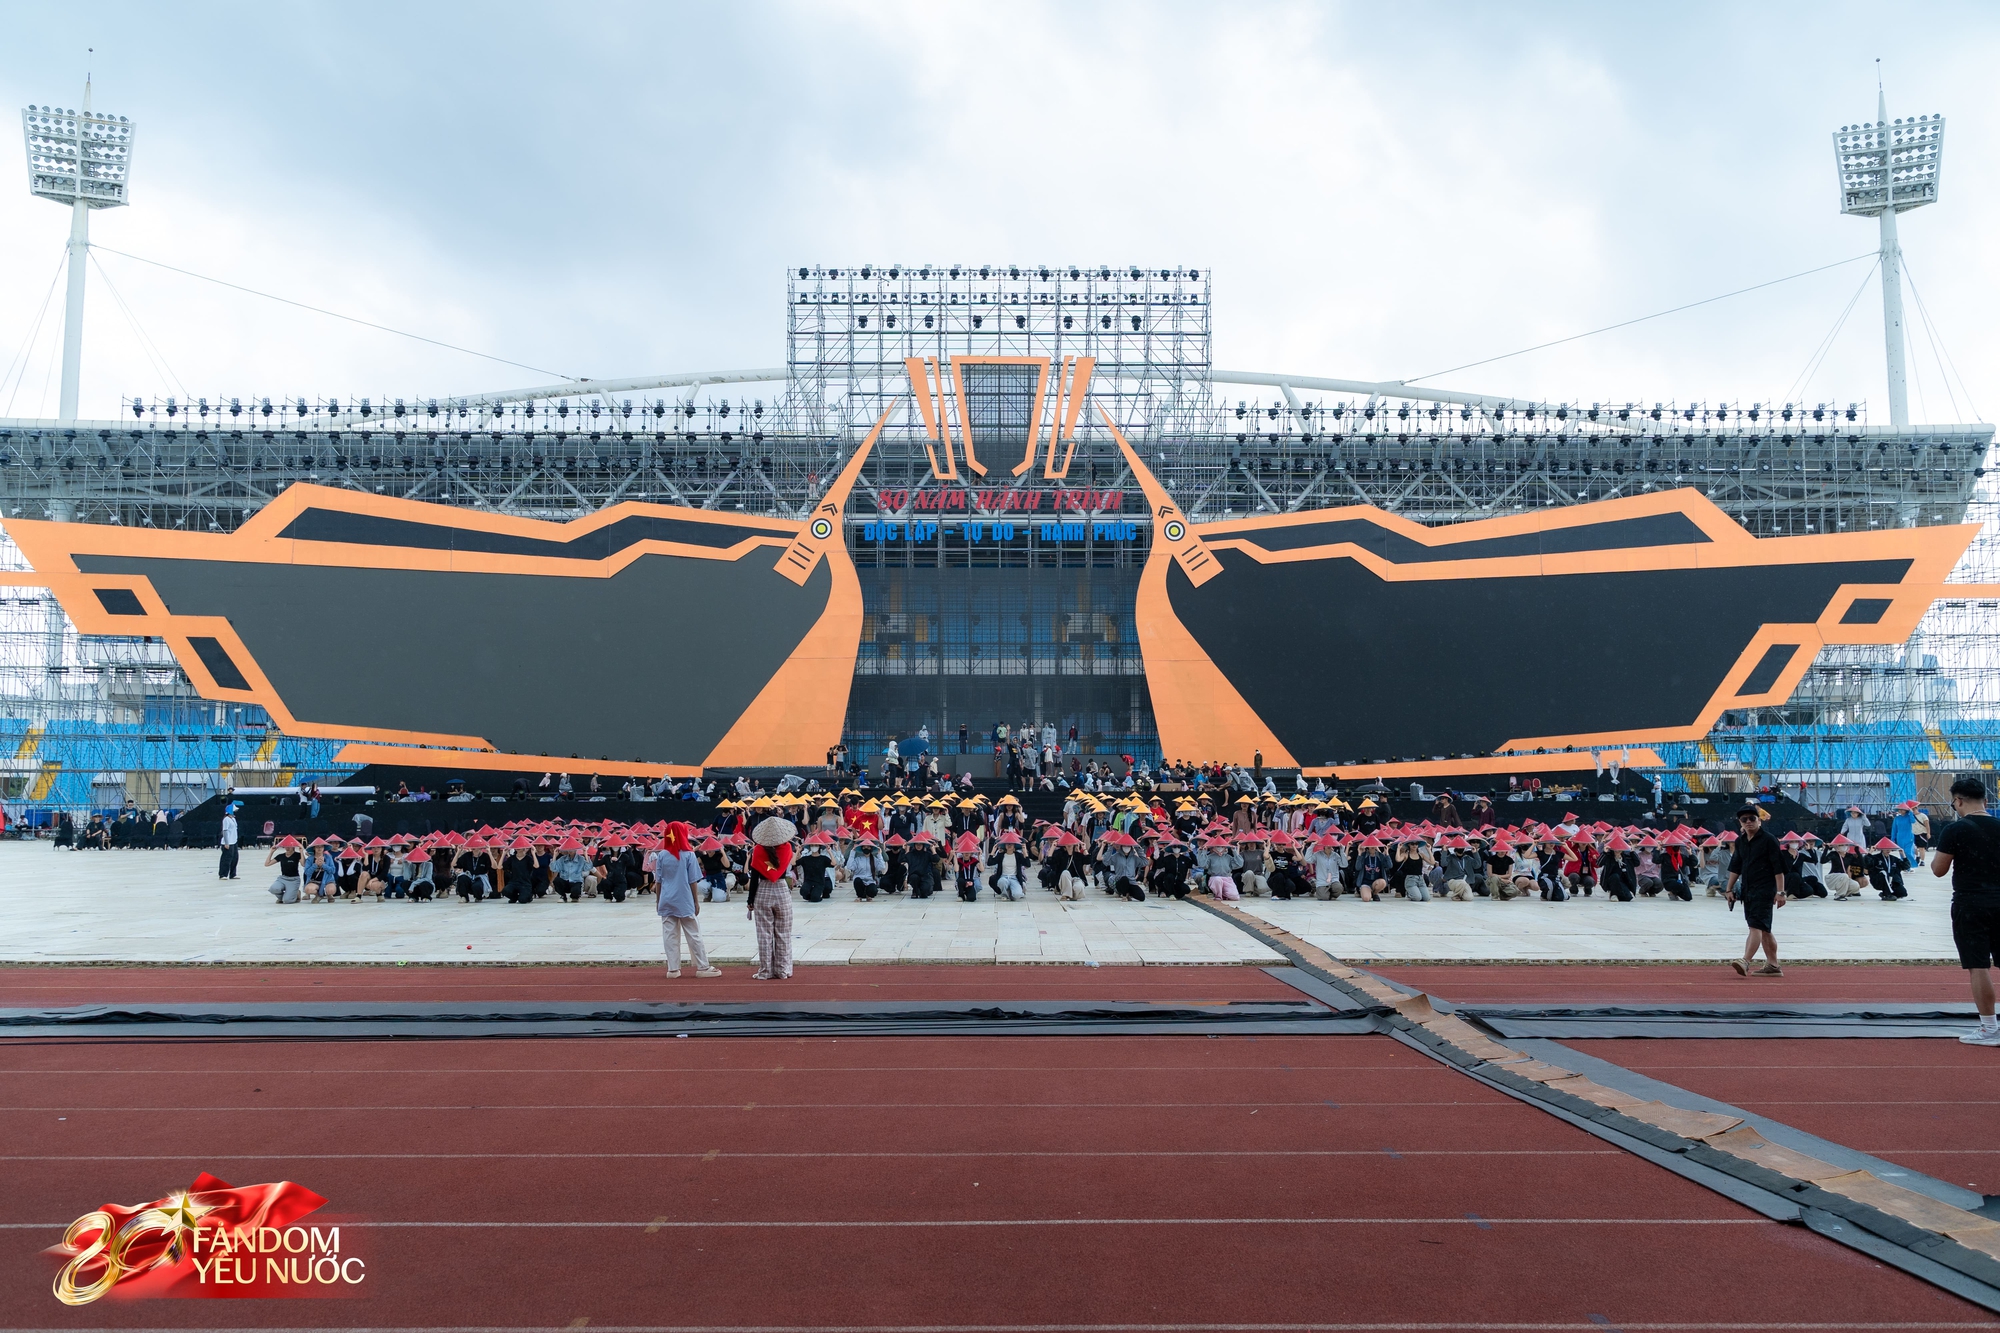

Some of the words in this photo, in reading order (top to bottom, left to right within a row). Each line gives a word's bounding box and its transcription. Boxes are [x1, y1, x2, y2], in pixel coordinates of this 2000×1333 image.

[877, 489, 909, 511] 80
[915, 484, 966, 510] NĂM
[975, 485, 1042, 510] HÀNH
[1052, 485, 1123, 510] TRÌNH
[864, 519, 898, 545] ĐỘC
[904, 519, 937, 545] LẬP
[962, 521, 984, 545] TỰ
[992, 523, 1014, 541] DO
[1041, 523, 1084, 545] HẠNH
[1094, 519, 1137, 541] PHÚC
